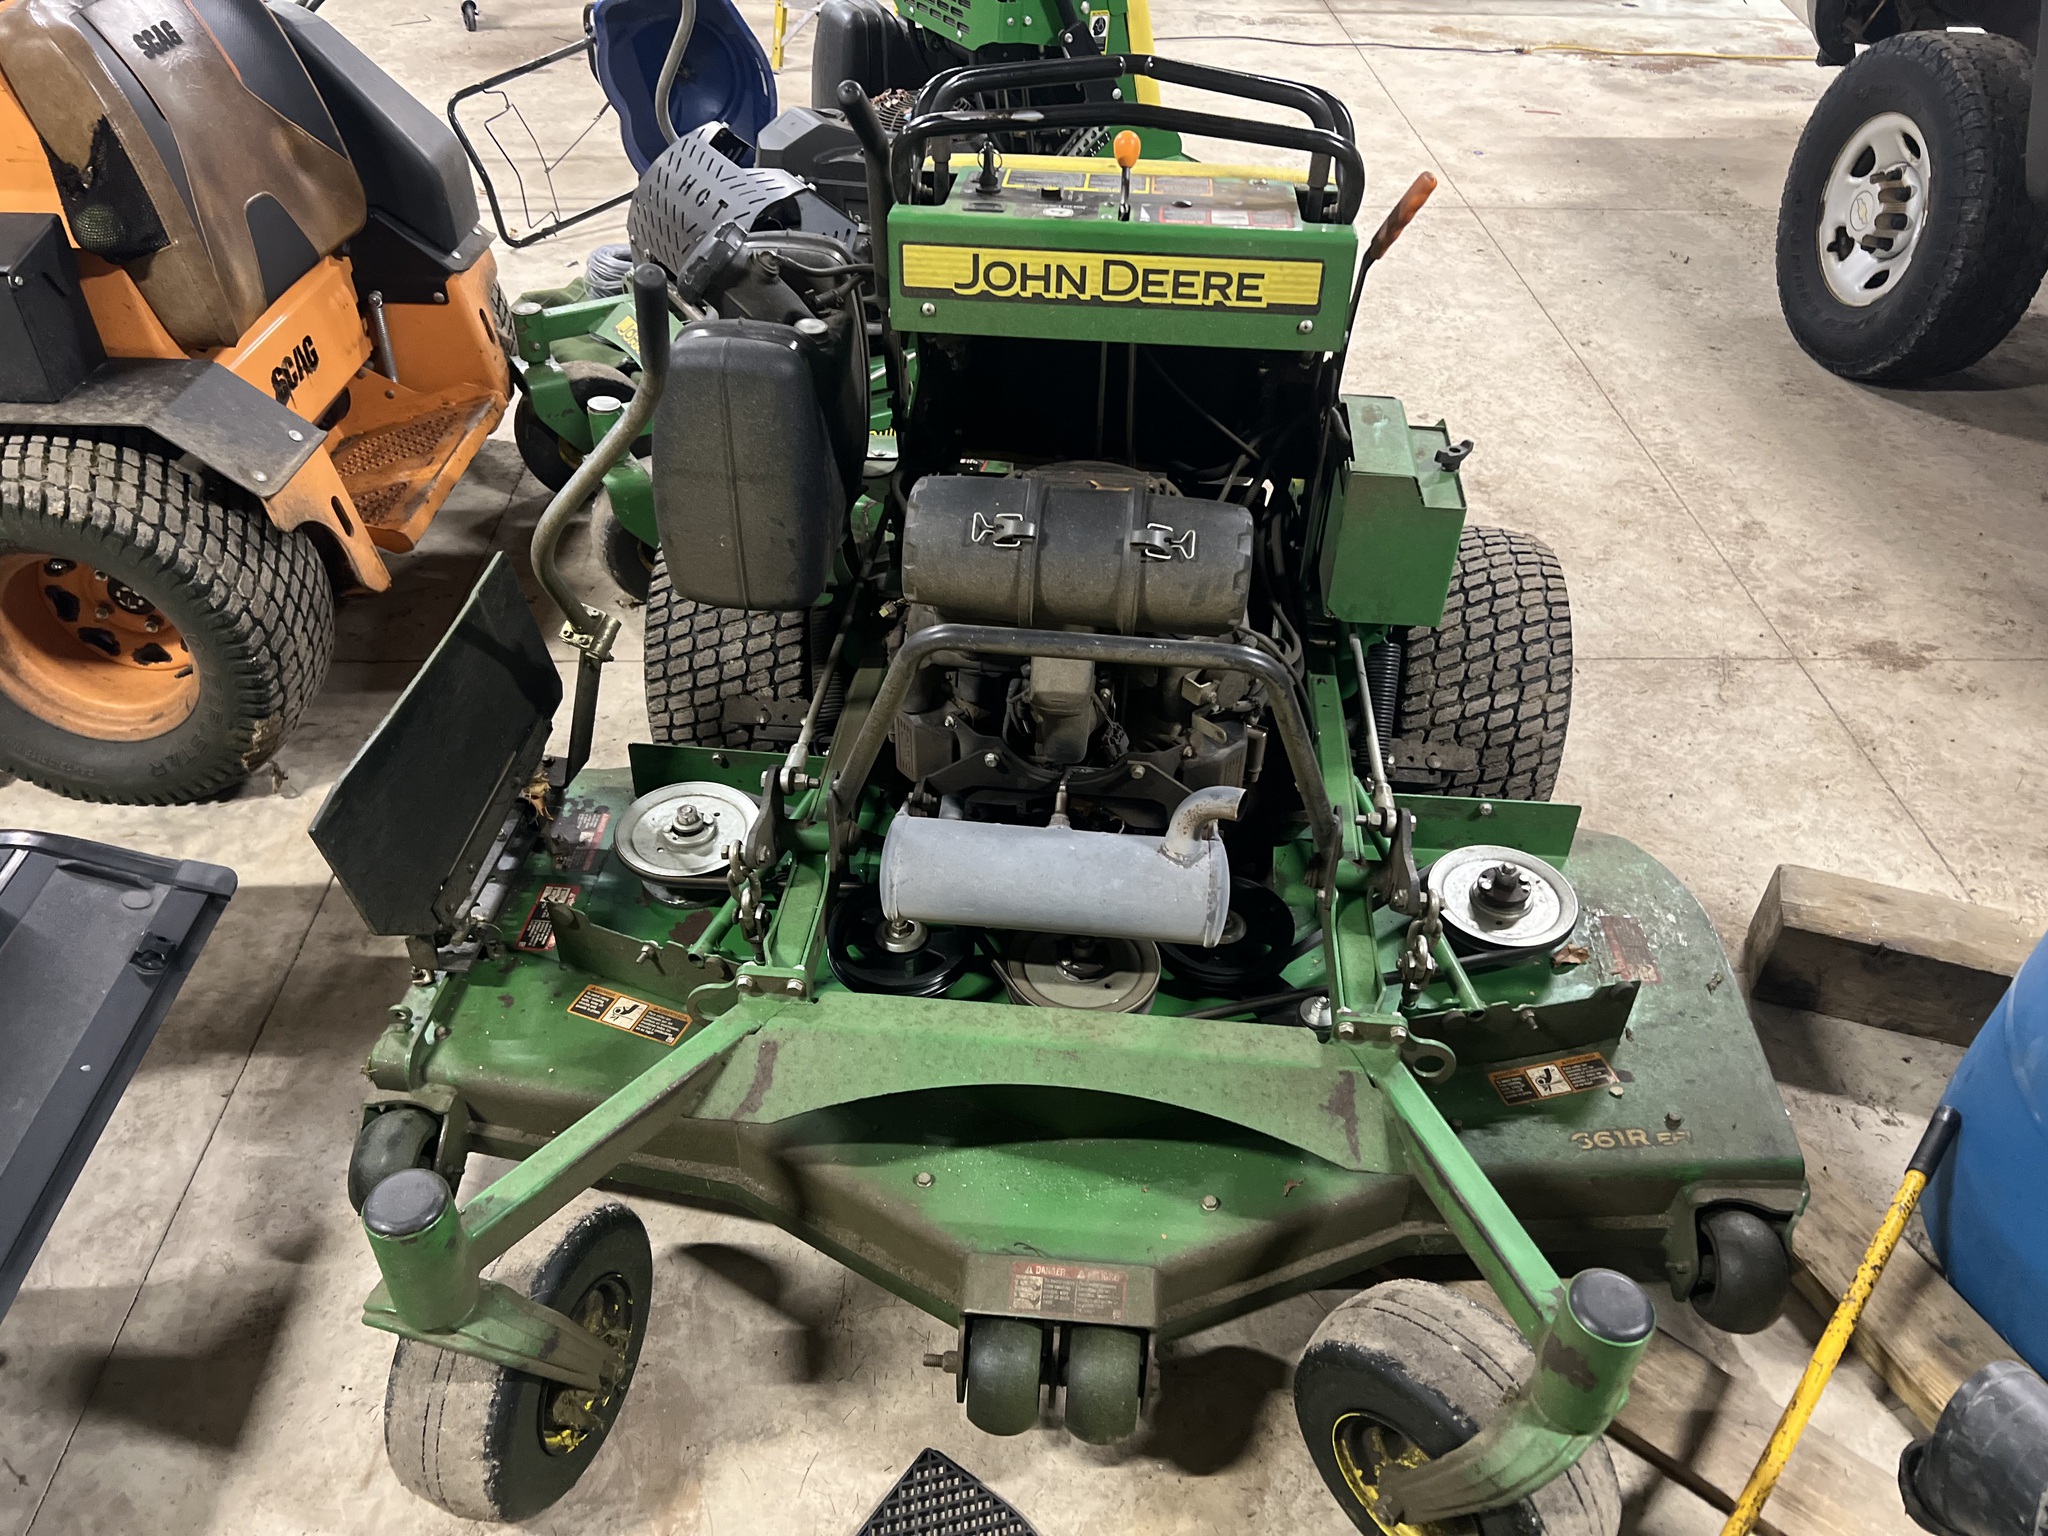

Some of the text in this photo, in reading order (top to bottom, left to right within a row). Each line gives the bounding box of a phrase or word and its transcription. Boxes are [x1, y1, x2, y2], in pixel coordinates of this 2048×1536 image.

[132, 20, 184, 59] SCAG
[678, 174, 729, 220] HOT
[954, 253, 1266, 302] JOHN DEERE
[271, 335, 319, 406] SCAG
[1035, 1265, 1067, 1276] DANGER
